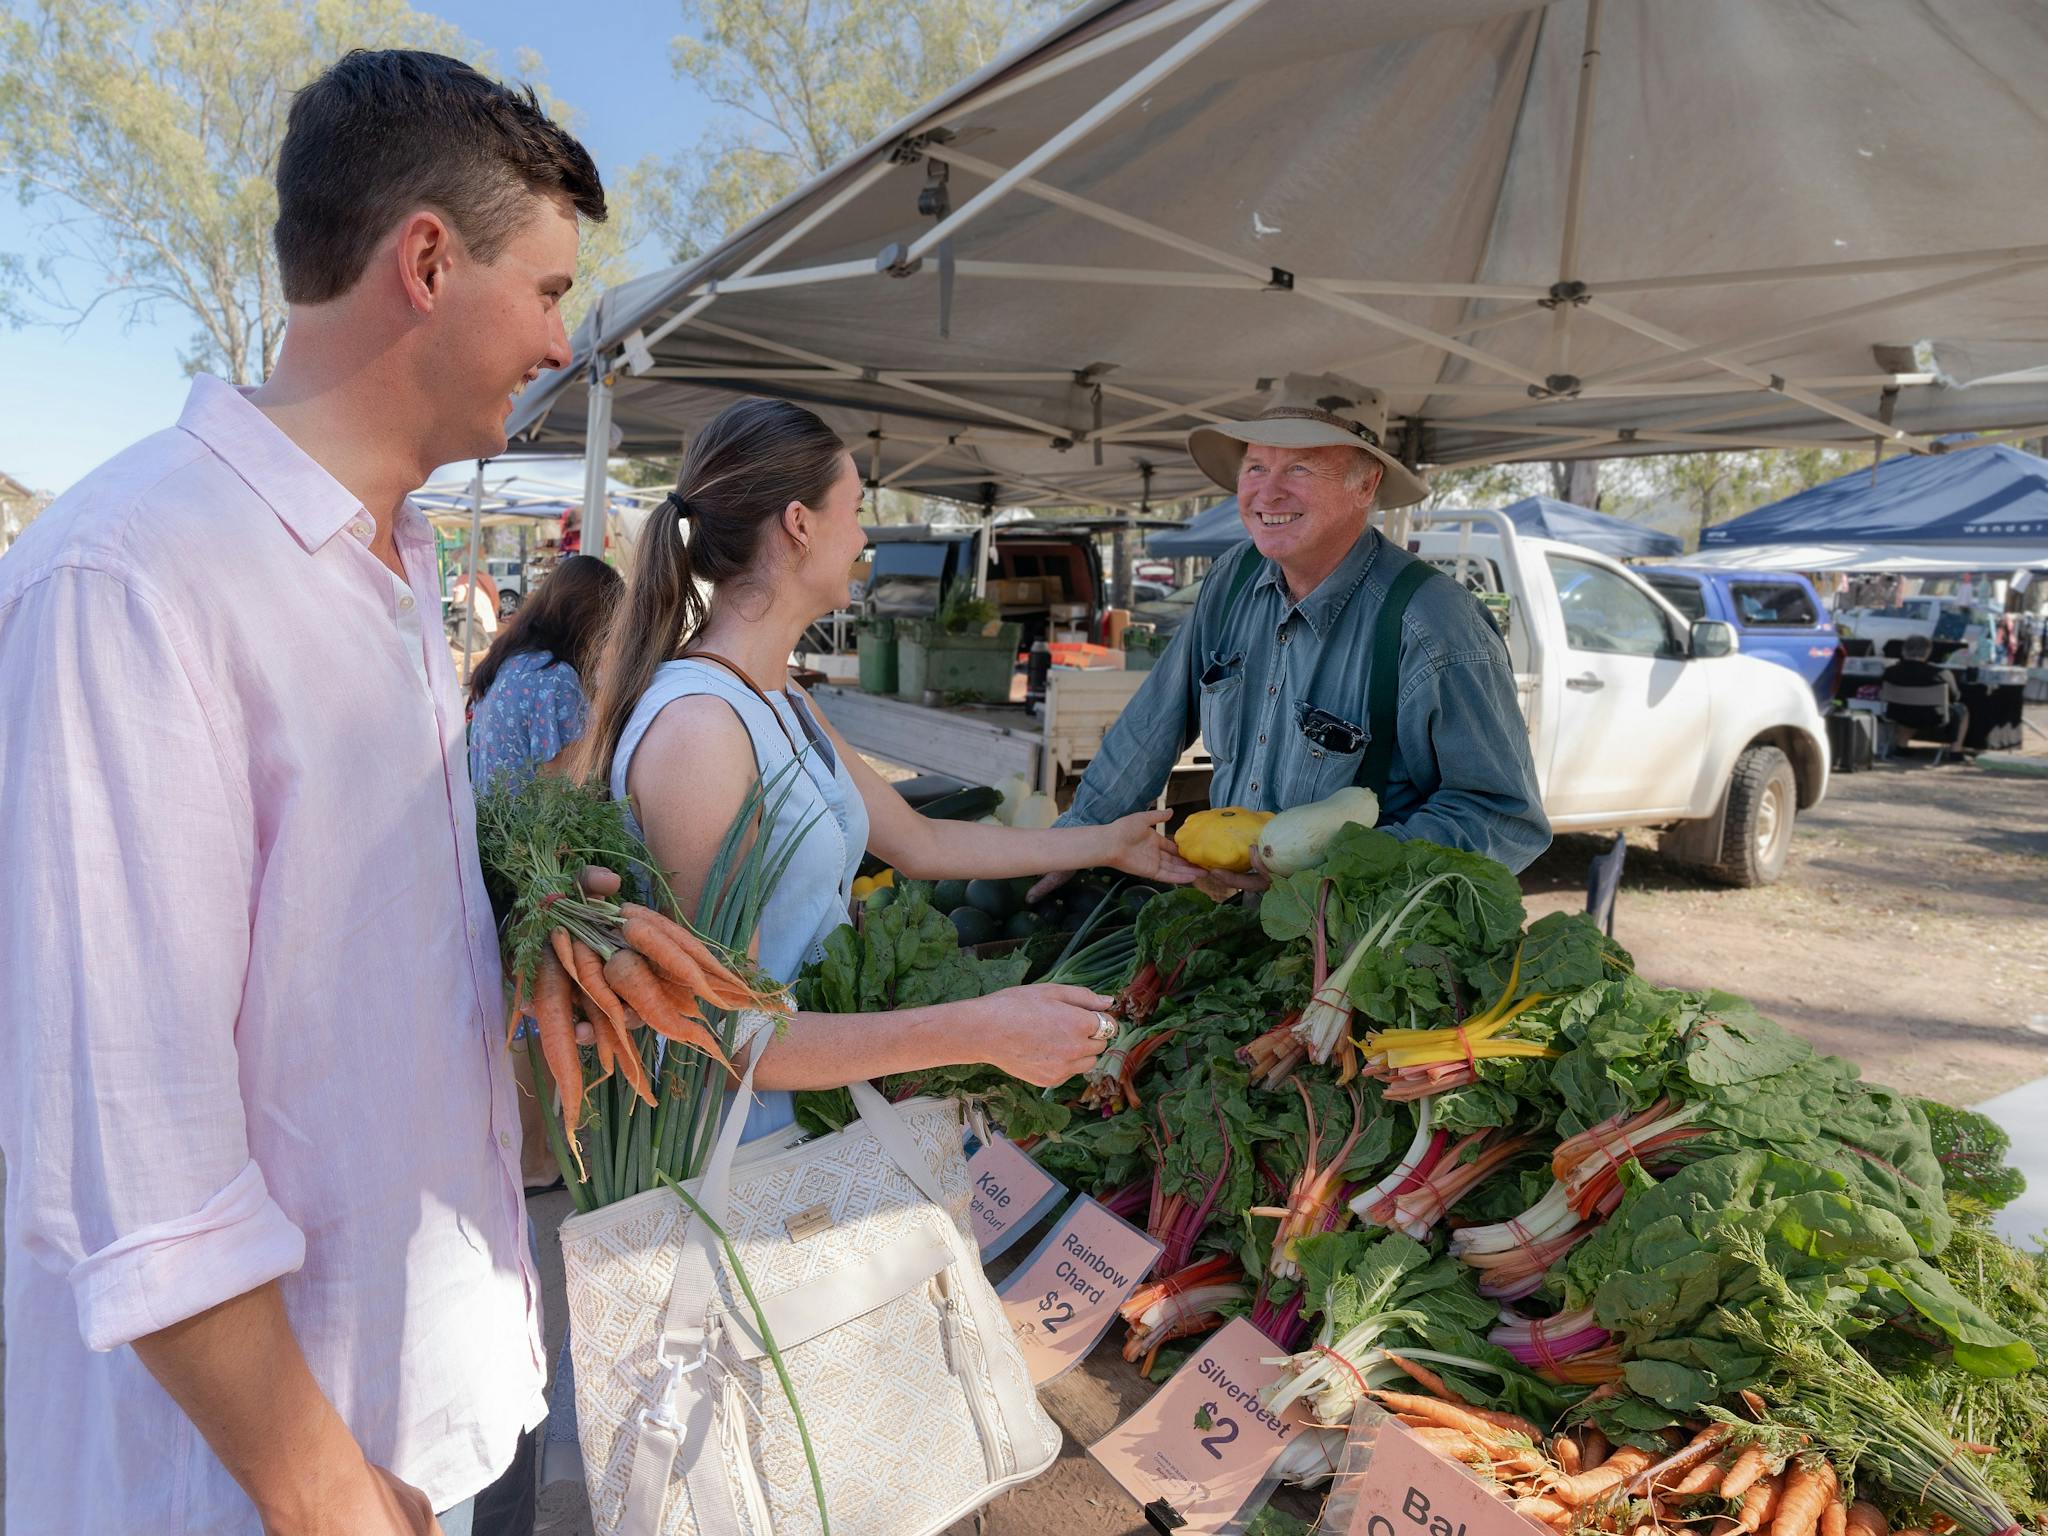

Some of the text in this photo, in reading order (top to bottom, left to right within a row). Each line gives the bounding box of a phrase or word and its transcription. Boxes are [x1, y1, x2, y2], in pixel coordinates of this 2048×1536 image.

[976, 1171, 1010, 1207] Kale
[983, 1209, 1006, 1230] Curl
[1062, 1233, 1128, 1289] Rainbow
[1055, 1261, 1105, 1305] Chard
[1037, 1291, 1075, 1334] $2
[1198, 1358, 1293, 1439] Silverbeet
